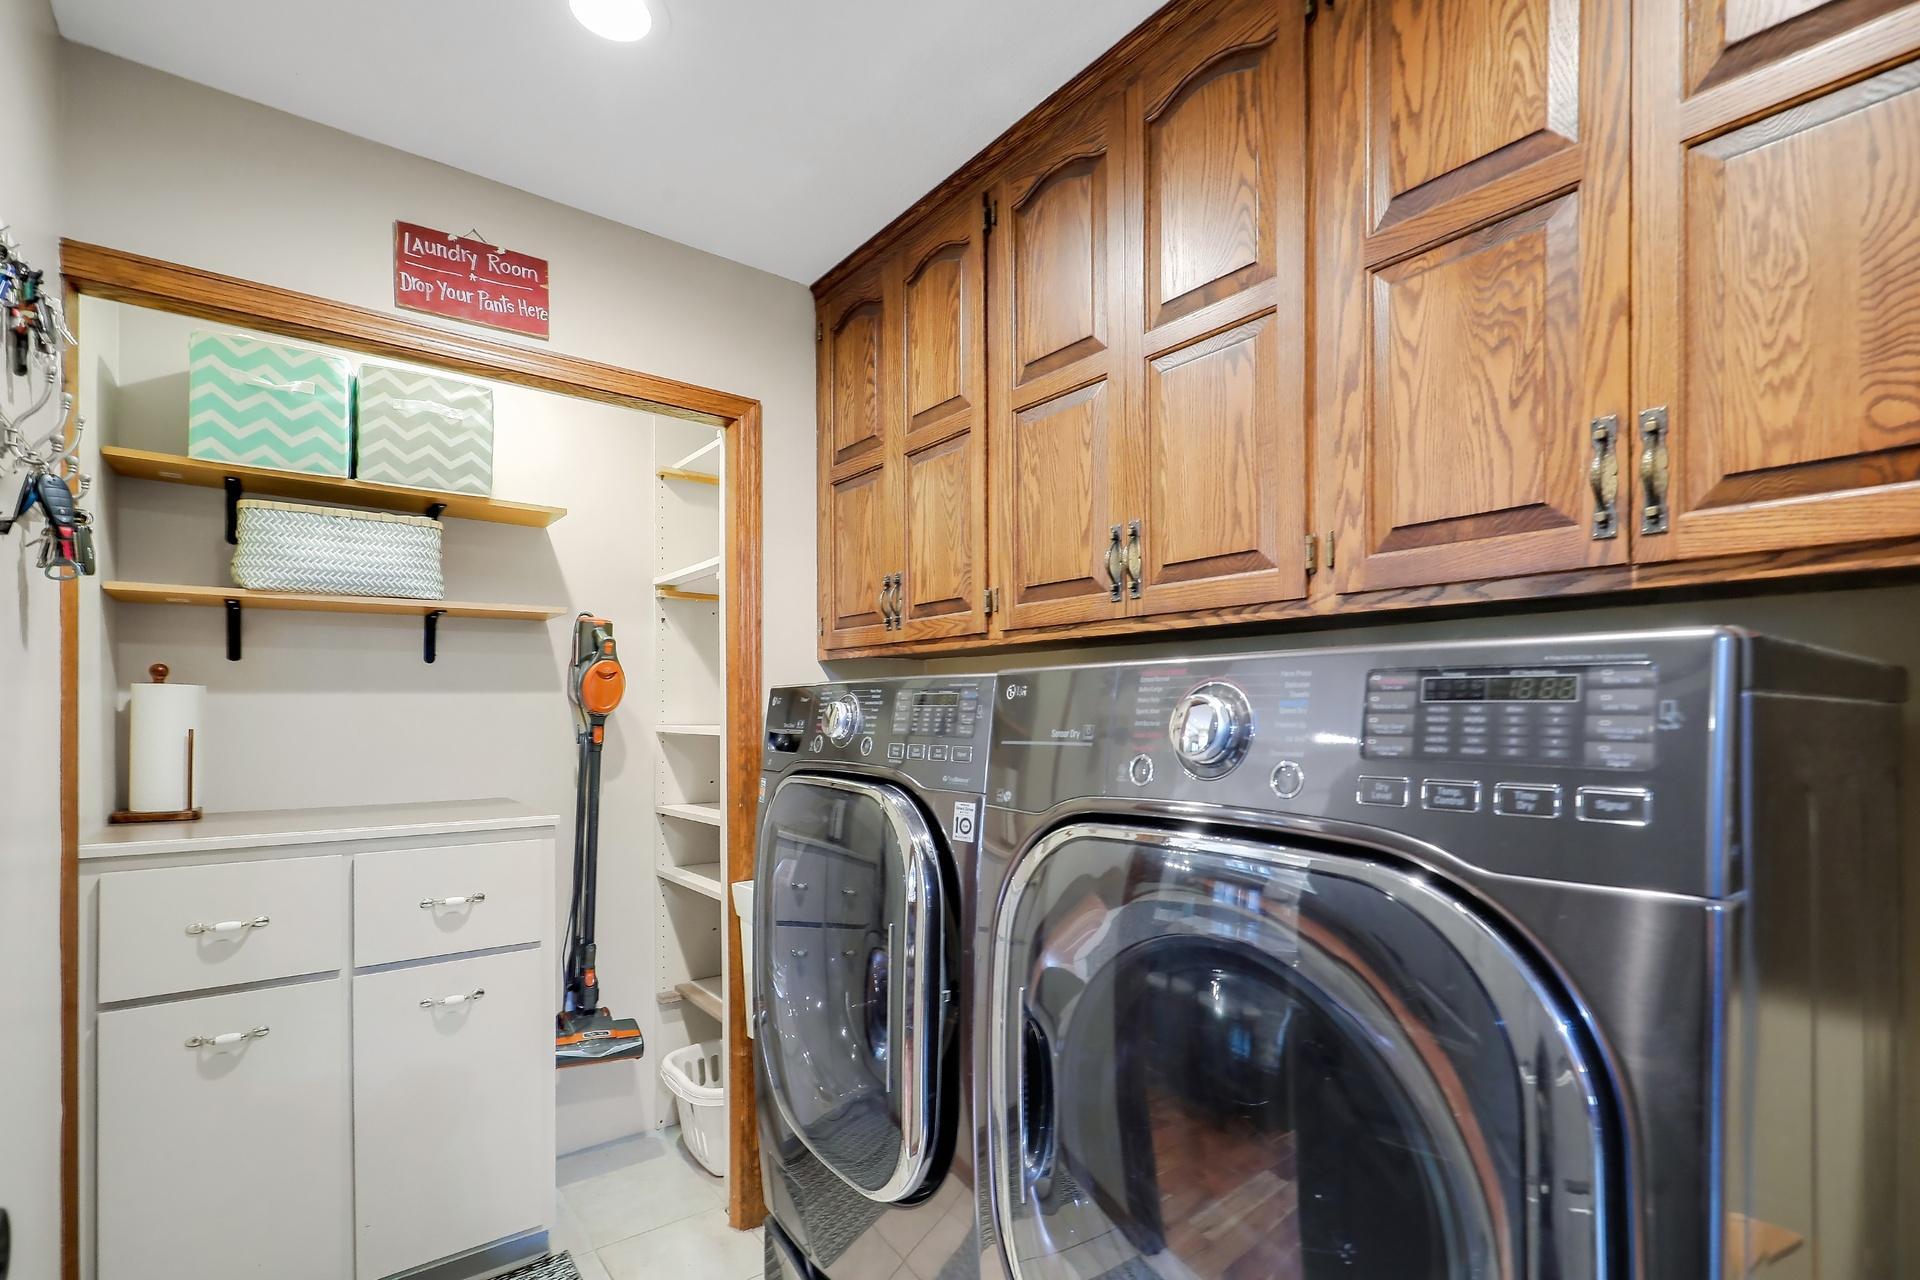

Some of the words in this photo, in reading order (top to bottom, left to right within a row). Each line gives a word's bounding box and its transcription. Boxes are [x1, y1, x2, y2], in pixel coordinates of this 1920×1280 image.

[487, 253, 538, 282] Room
[400, 272, 434, 301] Drop
[436, 280, 474, 304] Your
[478, 290, 515, 313] Pants
[518, 299, 548, 321] Here
